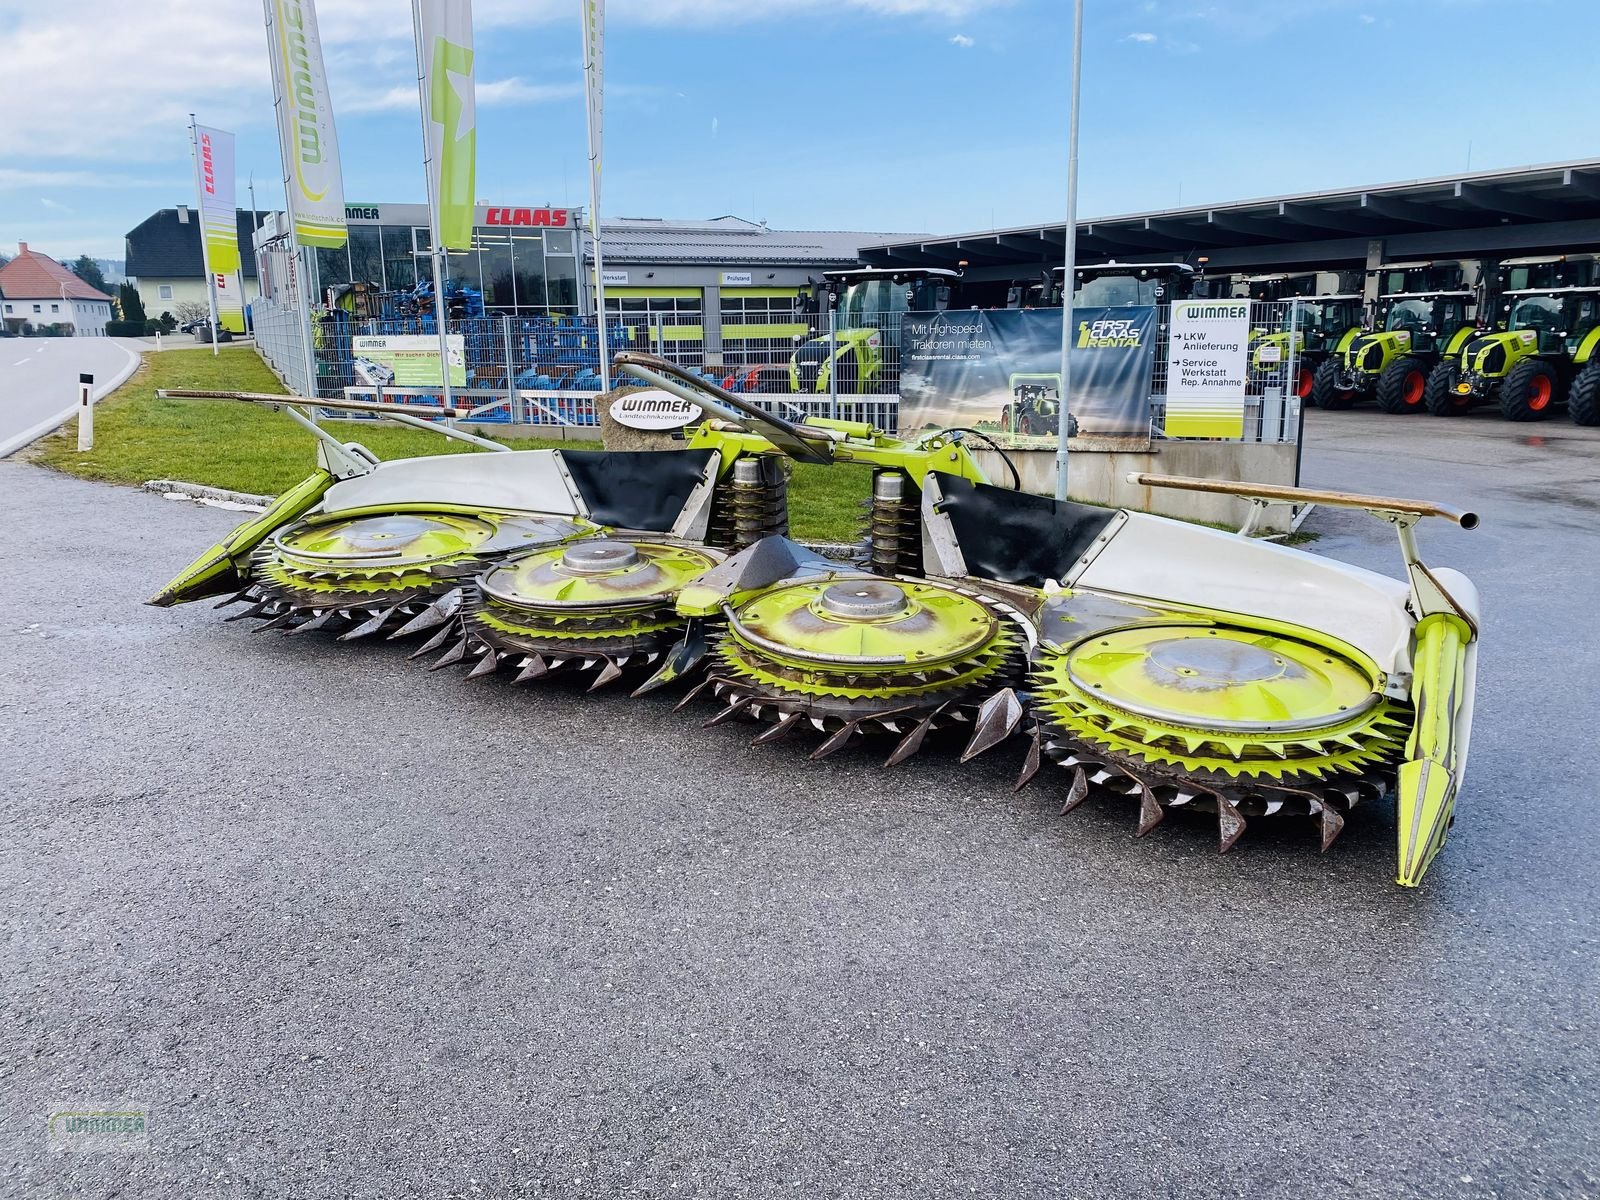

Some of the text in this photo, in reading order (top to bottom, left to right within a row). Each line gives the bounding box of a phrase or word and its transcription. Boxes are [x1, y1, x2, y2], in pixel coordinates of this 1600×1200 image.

[283, 0, 321, 164] WIMME
[202, 133, 215, 195] CLAAS
[345, 207, 379, 220] MMER
[486, 208, 567, 226] CLAAS
[1187, 306, 1247, 319] WIMMER
[911, 323, 983, 337] Mit Highspeed
[1092, 320, 1134, 330] FIRST
[1090, 328, 1140, 339] CLAAS
[1183, 332, 1206, 341] LKW
[360, 340, 387, 348] WIMMER
[911, 339, 994, 350] Traktoren mieten.
[1087, 338, 1142, 348] RENTAL
[1183, 342, 1239, 352] Anlieferung
[1182, 358, 1218, 367] Service
[1182, 368, 1226, 377] Werkstatt
[1181, 378, 1242, 387] Rep. Annahme
[622, 399, 692, 412] WIMMER
[619, 412, 690, 421] Landtechnikzentrum
